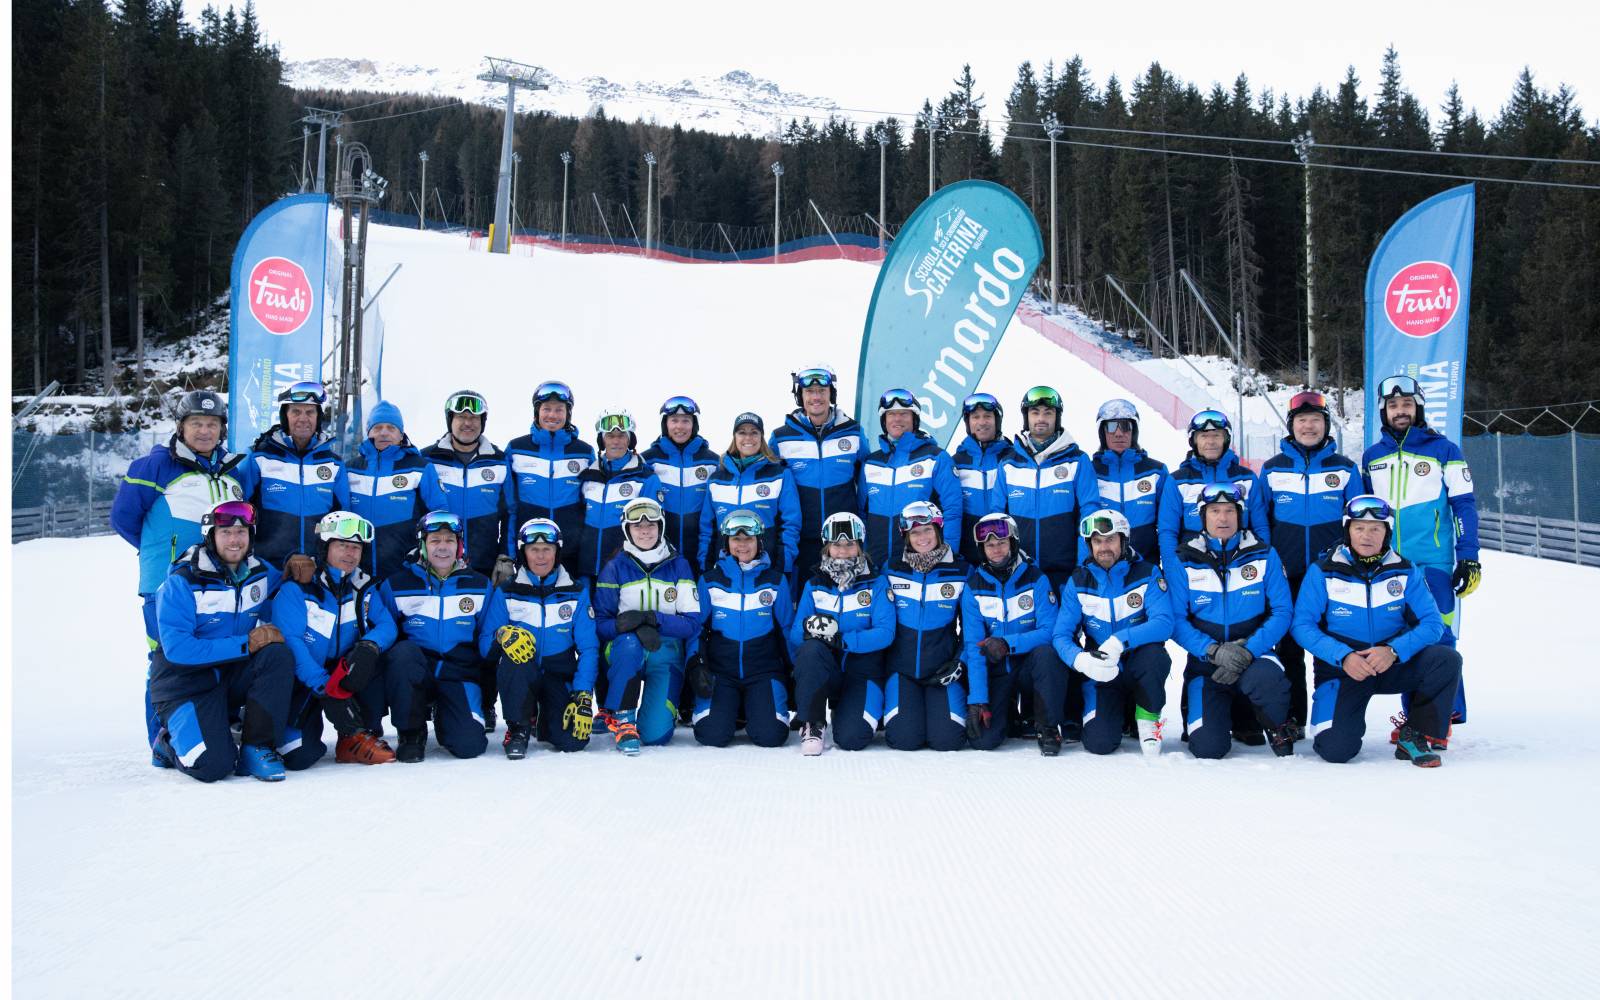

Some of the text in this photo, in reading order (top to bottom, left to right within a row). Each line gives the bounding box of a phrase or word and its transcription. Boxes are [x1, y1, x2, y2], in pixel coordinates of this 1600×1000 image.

[914, 245, 942, 282] SCUOLA
[1409, 273, 1440, 281] ORIGINAL
[254, 275, 306, 313] Trudi
[1392, 283, 1453, 314] Trudi
[919, 247, 1026, 429] ernardo
[1449, 360, 1460, 400] VALFURVA
